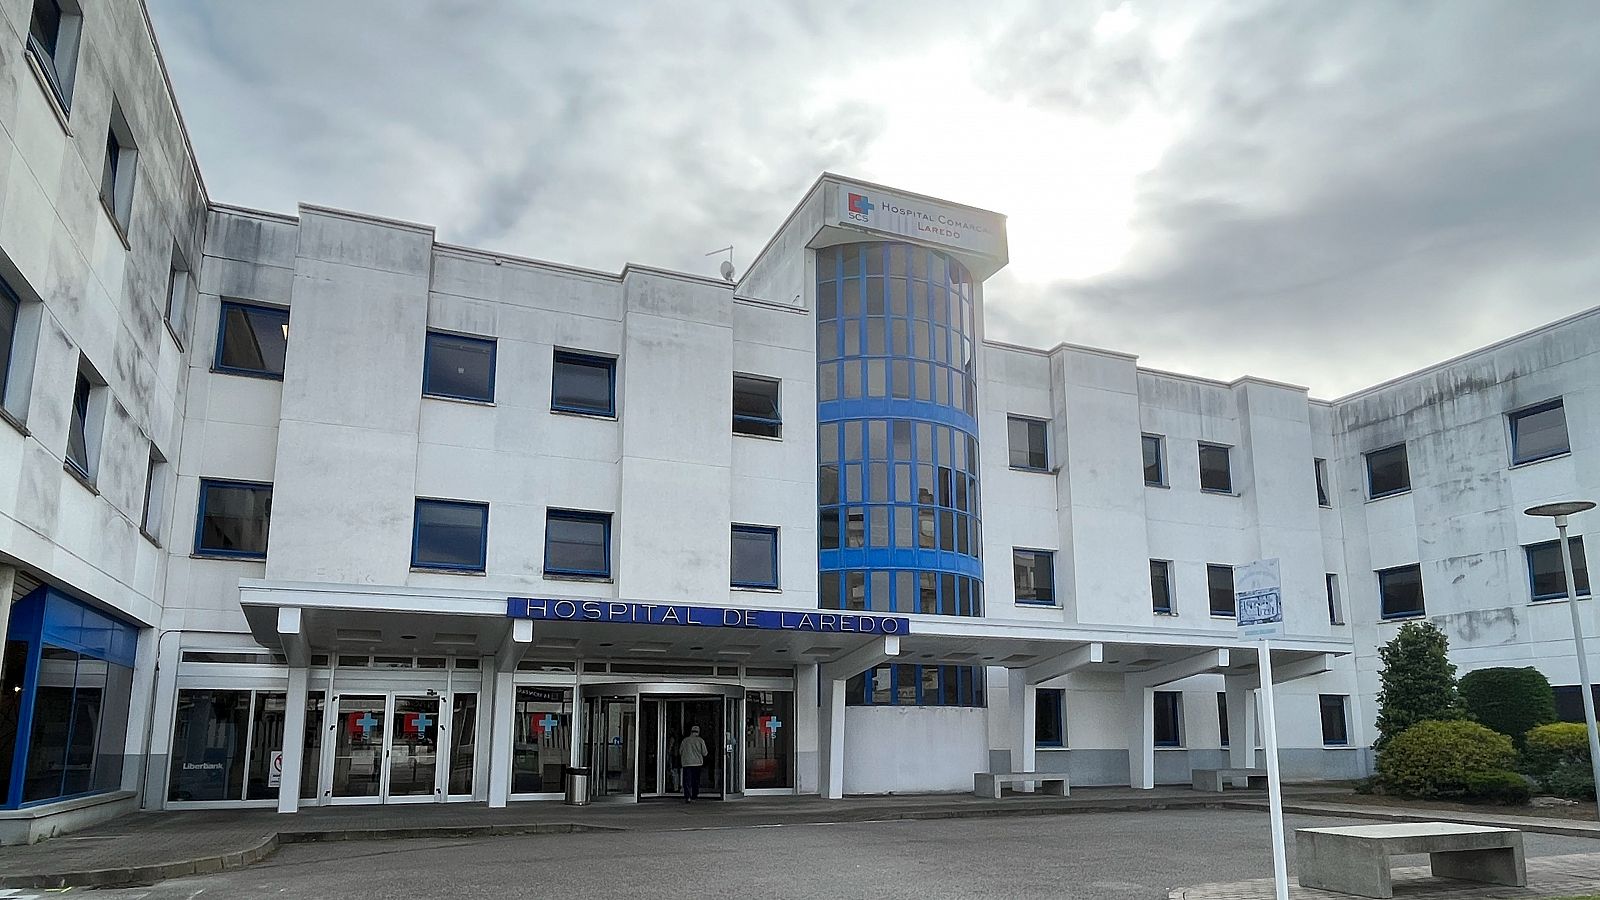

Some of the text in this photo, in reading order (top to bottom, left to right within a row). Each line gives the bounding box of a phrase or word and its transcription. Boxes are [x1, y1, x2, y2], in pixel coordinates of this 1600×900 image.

[848, 212, 869, 223] SCS
[917, 222, 961, 239] LAREDO
[526, 599, 899, 634] HOSPITAL DE LAREDO
[182, 762, 224, 770] Liberbank
